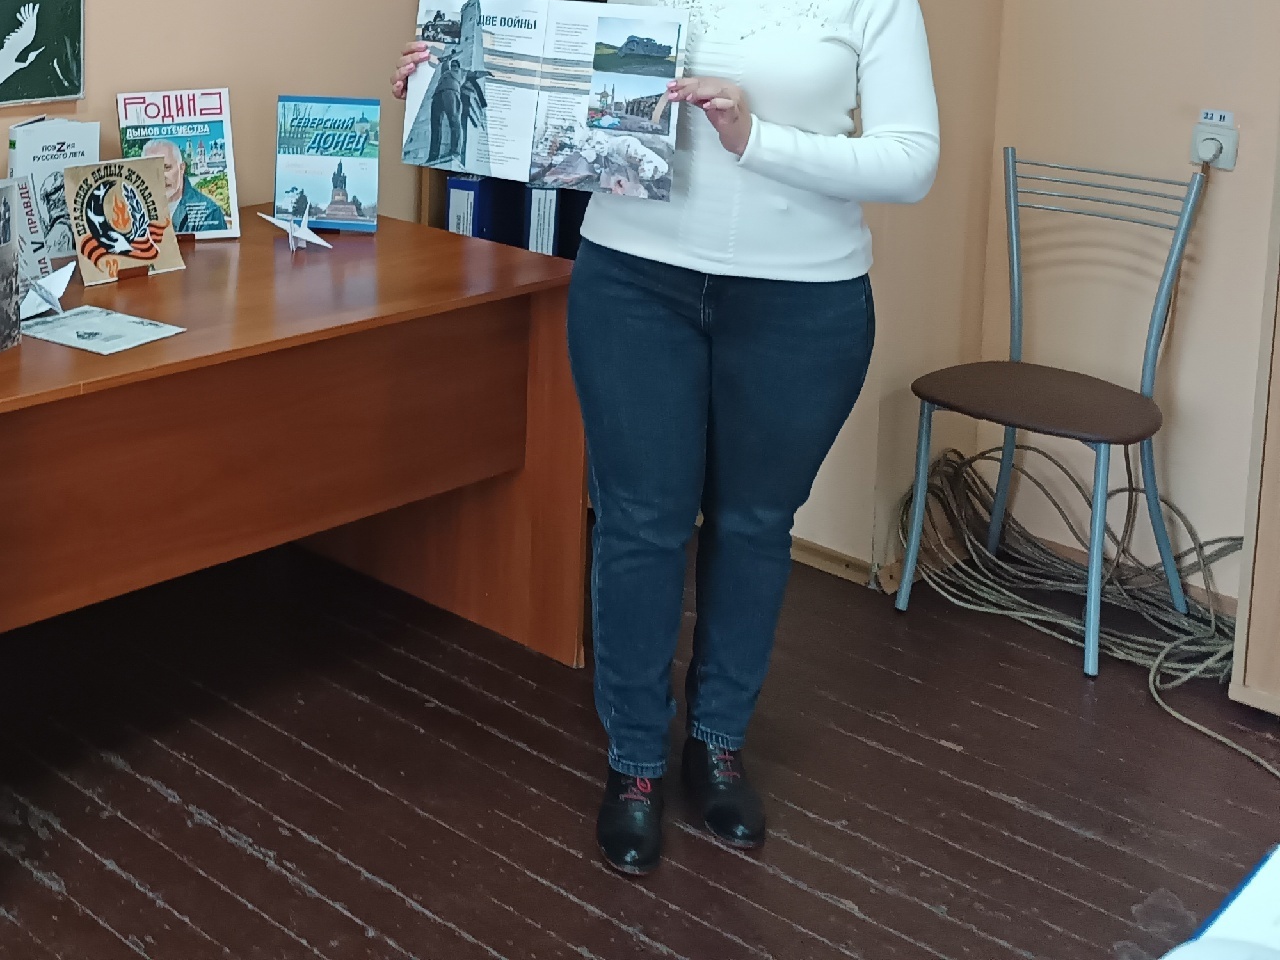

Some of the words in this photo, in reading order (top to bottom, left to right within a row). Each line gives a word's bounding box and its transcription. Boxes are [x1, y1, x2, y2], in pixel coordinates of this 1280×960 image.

[477, 14, 498, 27] ДВЕ
[499, 15, 537, 30] ВОЙНЫ
[126, 126, 159, 138] ДЫМОВ
[161, 124, 210, 136] ОТЕЧЕСТВА
[290, 116, 356, 130] СЕВЕРСКИЙ
[306, 131, 370, 157] ДОНЕЦ
[18, 182, 39, 235] ПРАВДЕ
